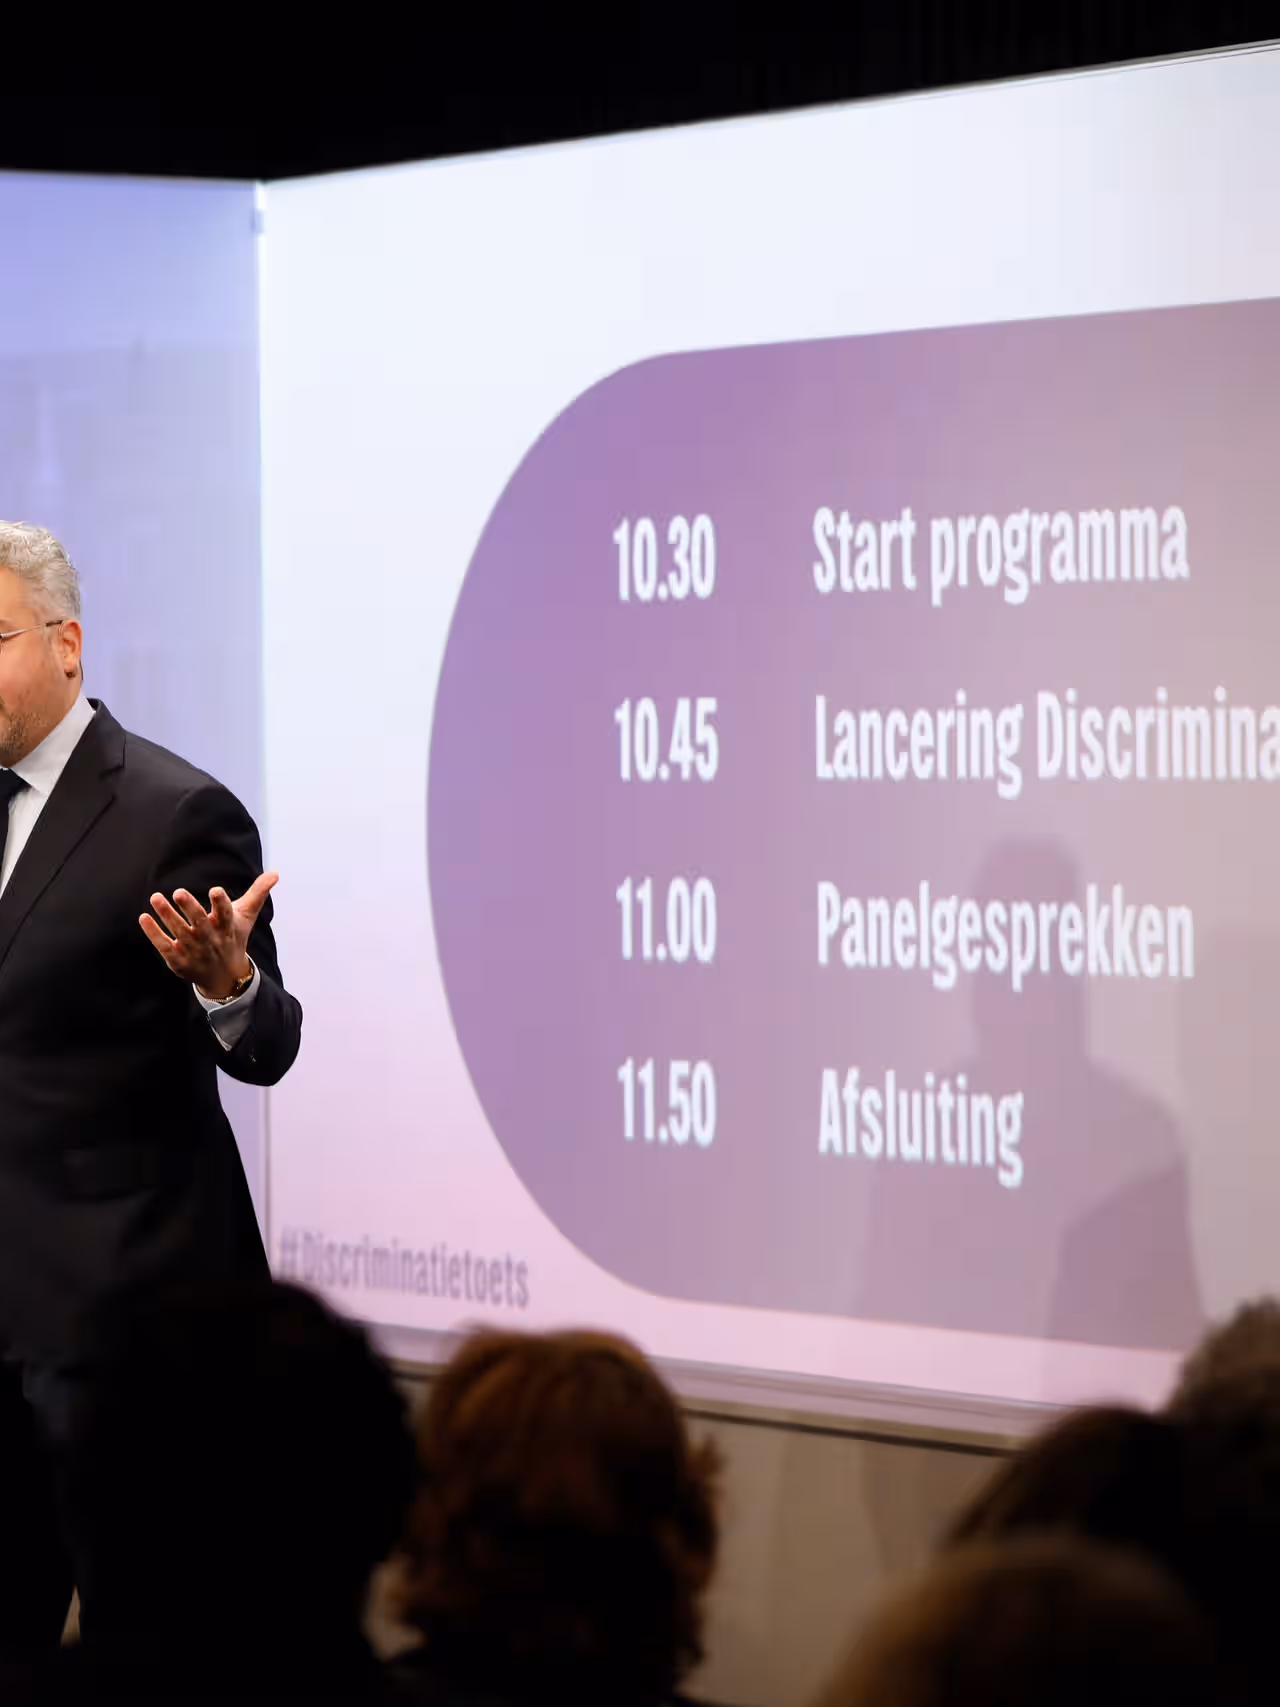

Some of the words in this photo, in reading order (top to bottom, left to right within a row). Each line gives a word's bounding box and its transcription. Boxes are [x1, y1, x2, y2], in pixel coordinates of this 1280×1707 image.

[613, 514, 716, 601] 10.30
[814, 506, 916, 593] Start
[930, 506, 1189, 607] programma
[614, 696, 719, 781] 10.45
[815, 688, 1023, 799] Lancering
[1036, 685, 1280, 781] Discrimina
[616, 875, 717, 963] 11.00
[817, 879, 1195, 992] Panelgesprekken
[618, 1056, 717, 1146] 11.50
[818, 1066, 1024, 1188] Afsluiting
[280, 1228, 531, 1310] #Discriminatietoets
